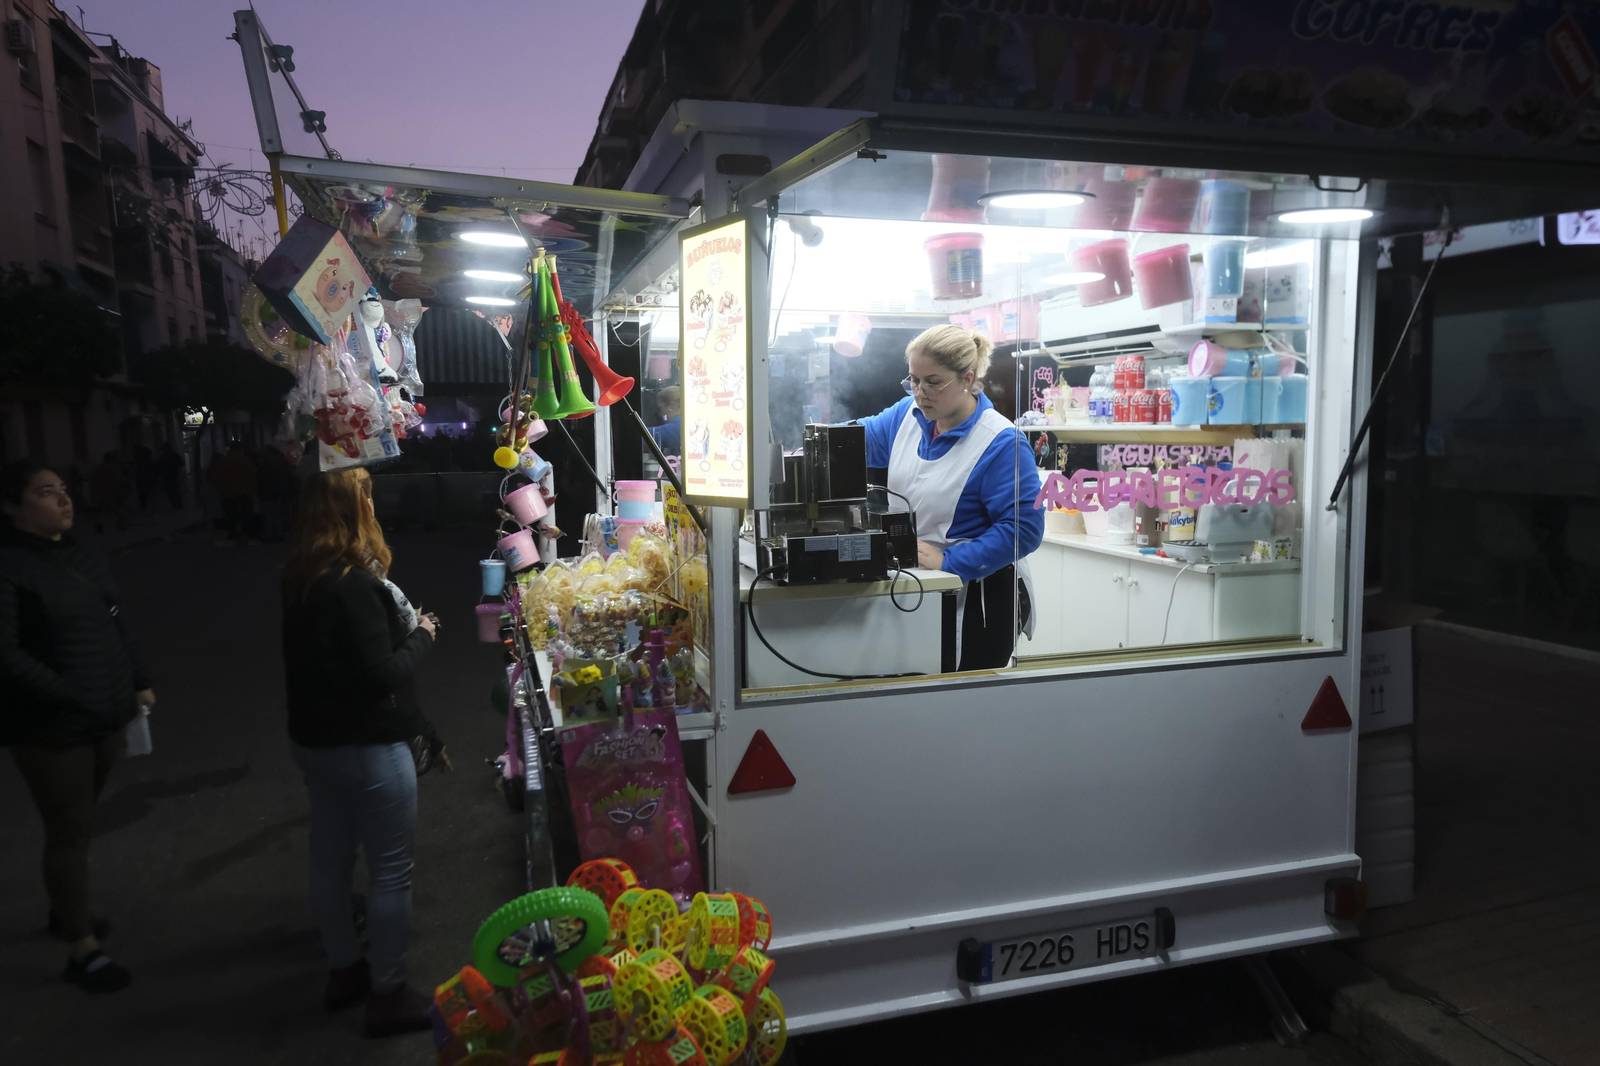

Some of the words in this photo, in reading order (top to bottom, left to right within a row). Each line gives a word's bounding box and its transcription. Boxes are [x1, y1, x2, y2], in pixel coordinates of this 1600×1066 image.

[685, 236, 743, 270] BUÑUELOS
[1367, 653, 1386, 664] MUY
[594, 737, 645, 756] FASHION
[614, 747, 636, 759] SET
[1000, 934, 1075, 976] 7226
[1096, 921, 1150, 959] HDS
